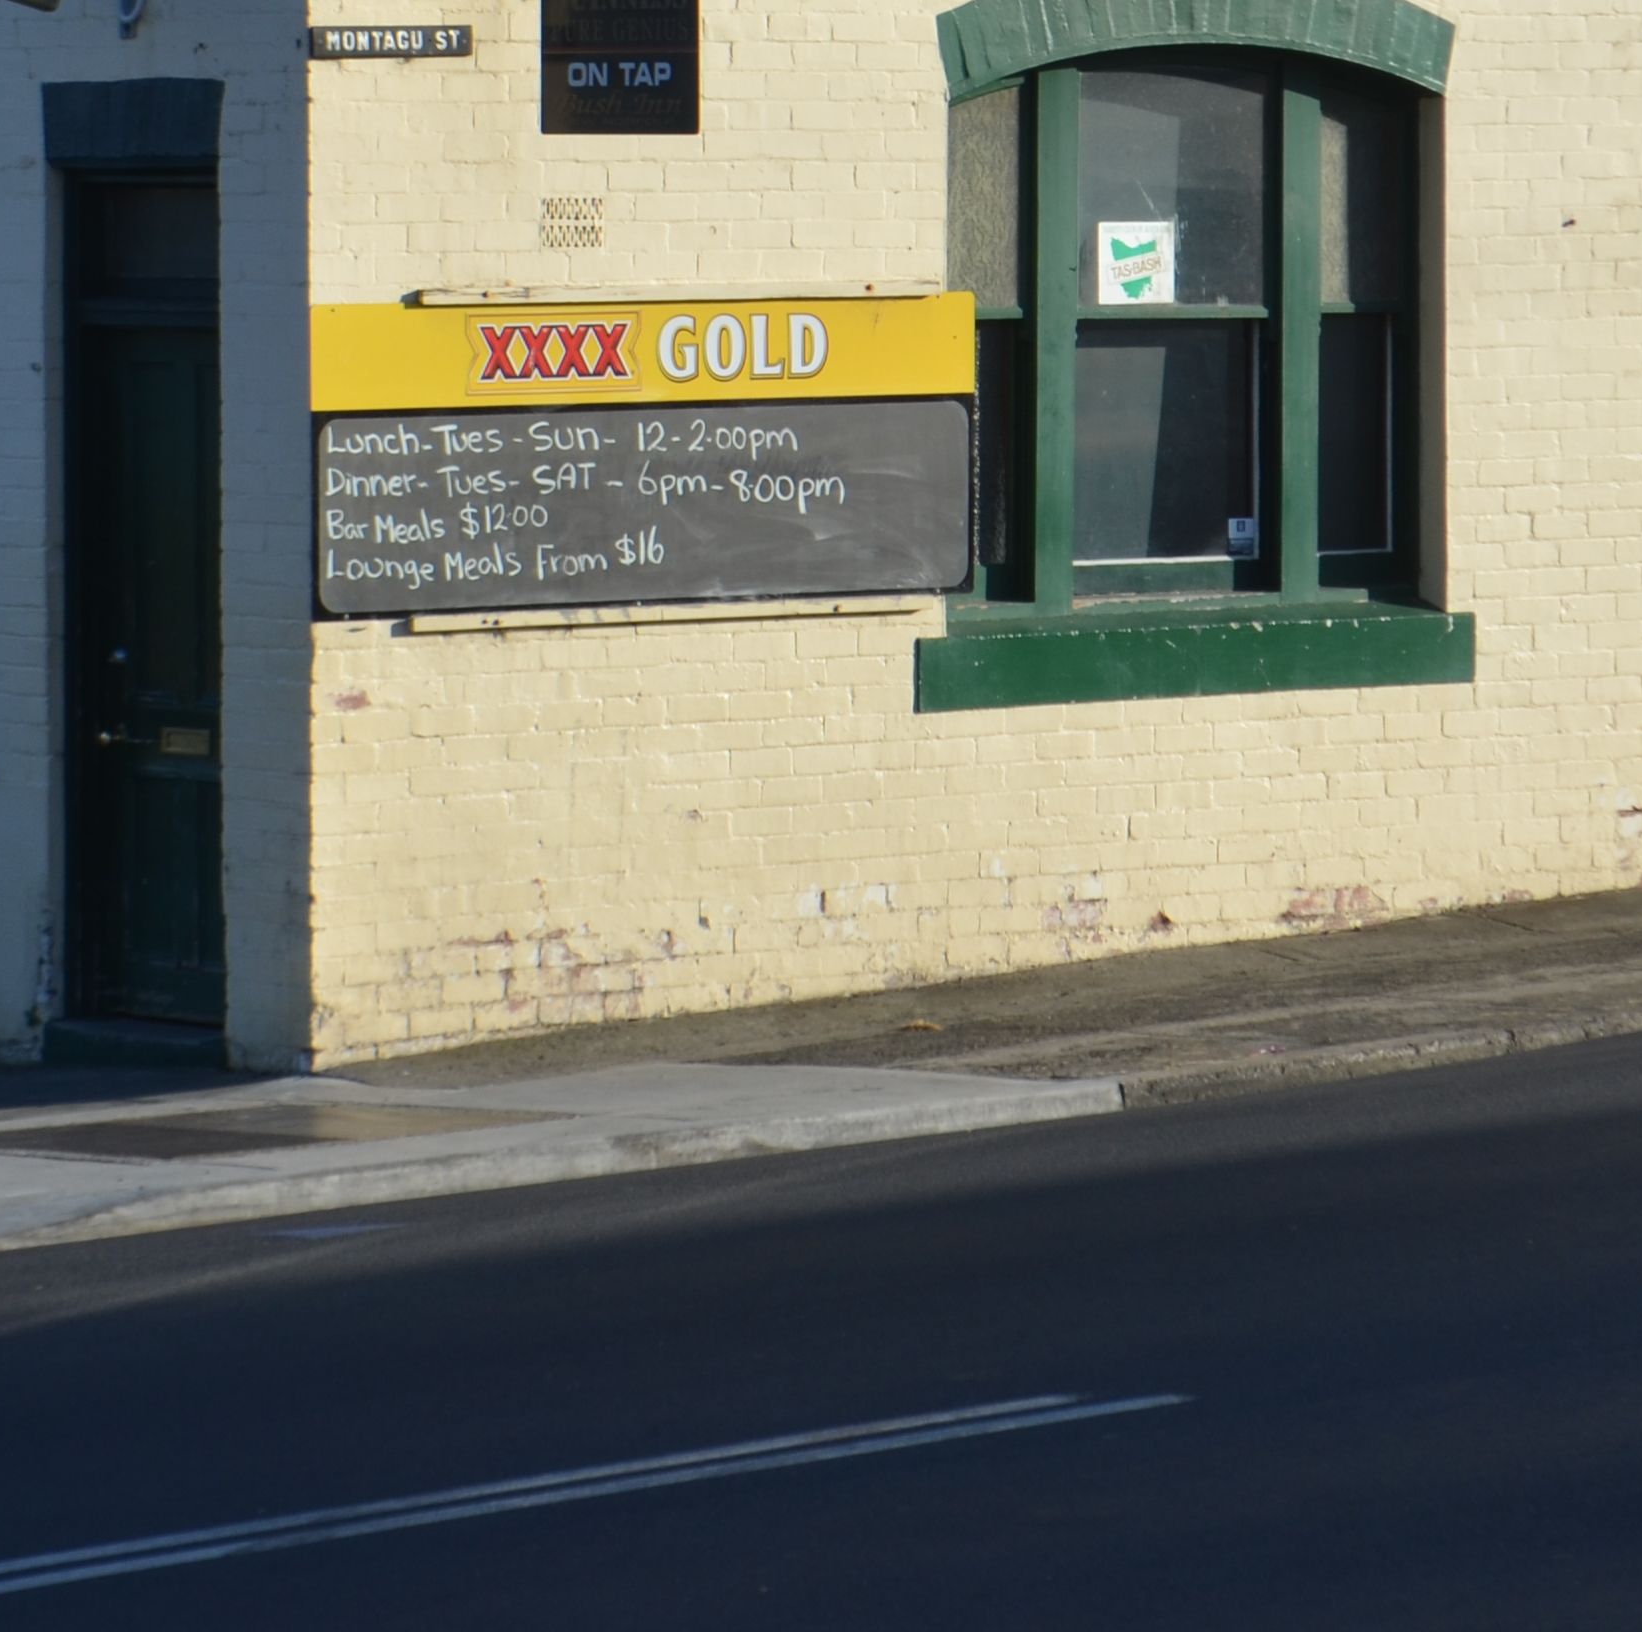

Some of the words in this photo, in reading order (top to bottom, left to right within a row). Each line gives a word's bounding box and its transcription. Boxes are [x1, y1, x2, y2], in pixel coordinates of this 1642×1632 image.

[326, 29, 424, 51] MONTAGU
[435, 29, 462, 51] ST
[567, 61, 609, 88] ON
[619, 61, 673, 87] TAP
[478, 321, 632, 382] XXXX
[657, 313, 829, 383] GOLD
[325, 508, 369, 540] Bar
[373, 507, 447, 544] Meals
[326, 548, 435, 590] Lounge
[444, 542, 523, 582] Meals
[535, 543, 609, 582] From
[614, 524, 666, 566] $16
